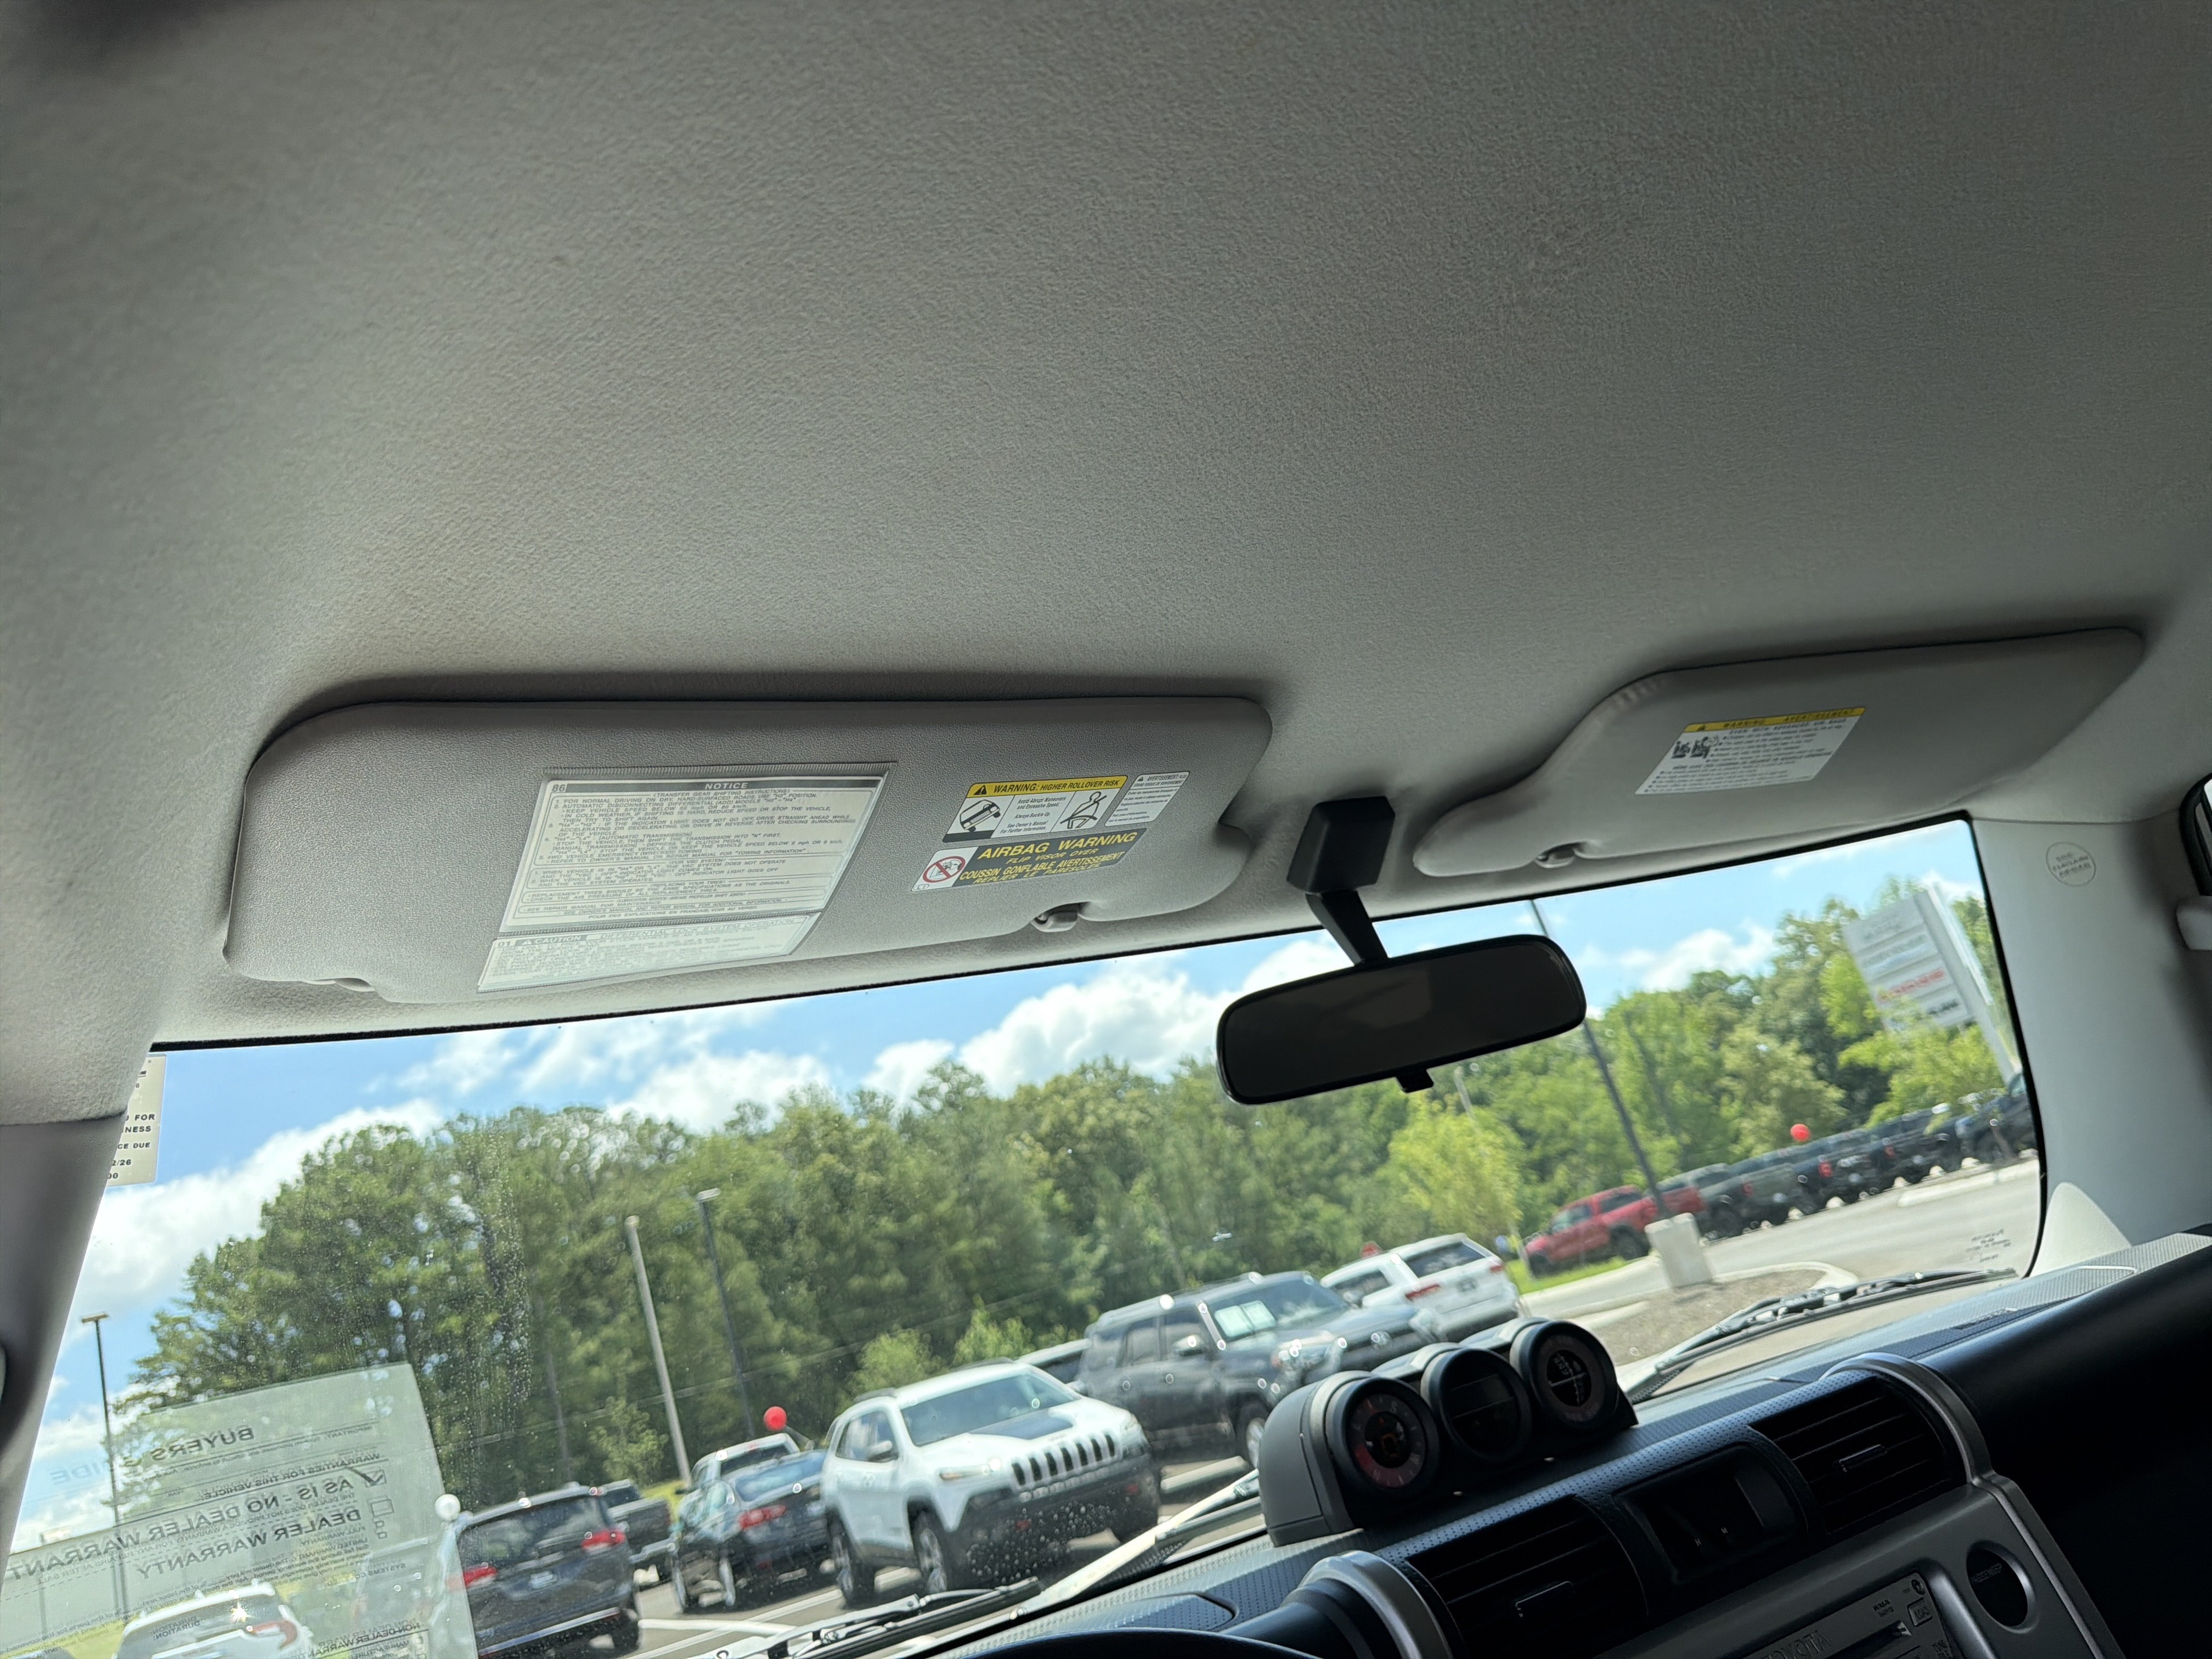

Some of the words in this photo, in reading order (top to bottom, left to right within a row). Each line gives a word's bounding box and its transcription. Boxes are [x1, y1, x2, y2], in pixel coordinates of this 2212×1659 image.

[994, 783, 1039, 793] WARNING:
[1068, 781, 1103, 789] ROLLOVER
[978, 842, 1048, 860] AIRBAG
[1059, 832, 1138, 850] WARNING
[1034, 852, 1068, 861] VISOR
[1072, 848, 1099, 856] OVER
[960, 869, 1000, 881] COUSSIN
[1003, 862, 1053, 876] GONFLABLE
[1058, 851, 1126, 868] AVERTISSEMENT
[973, 874, 1015, 884] REPLIER
[534, 935, 583, 944] CAUTION
